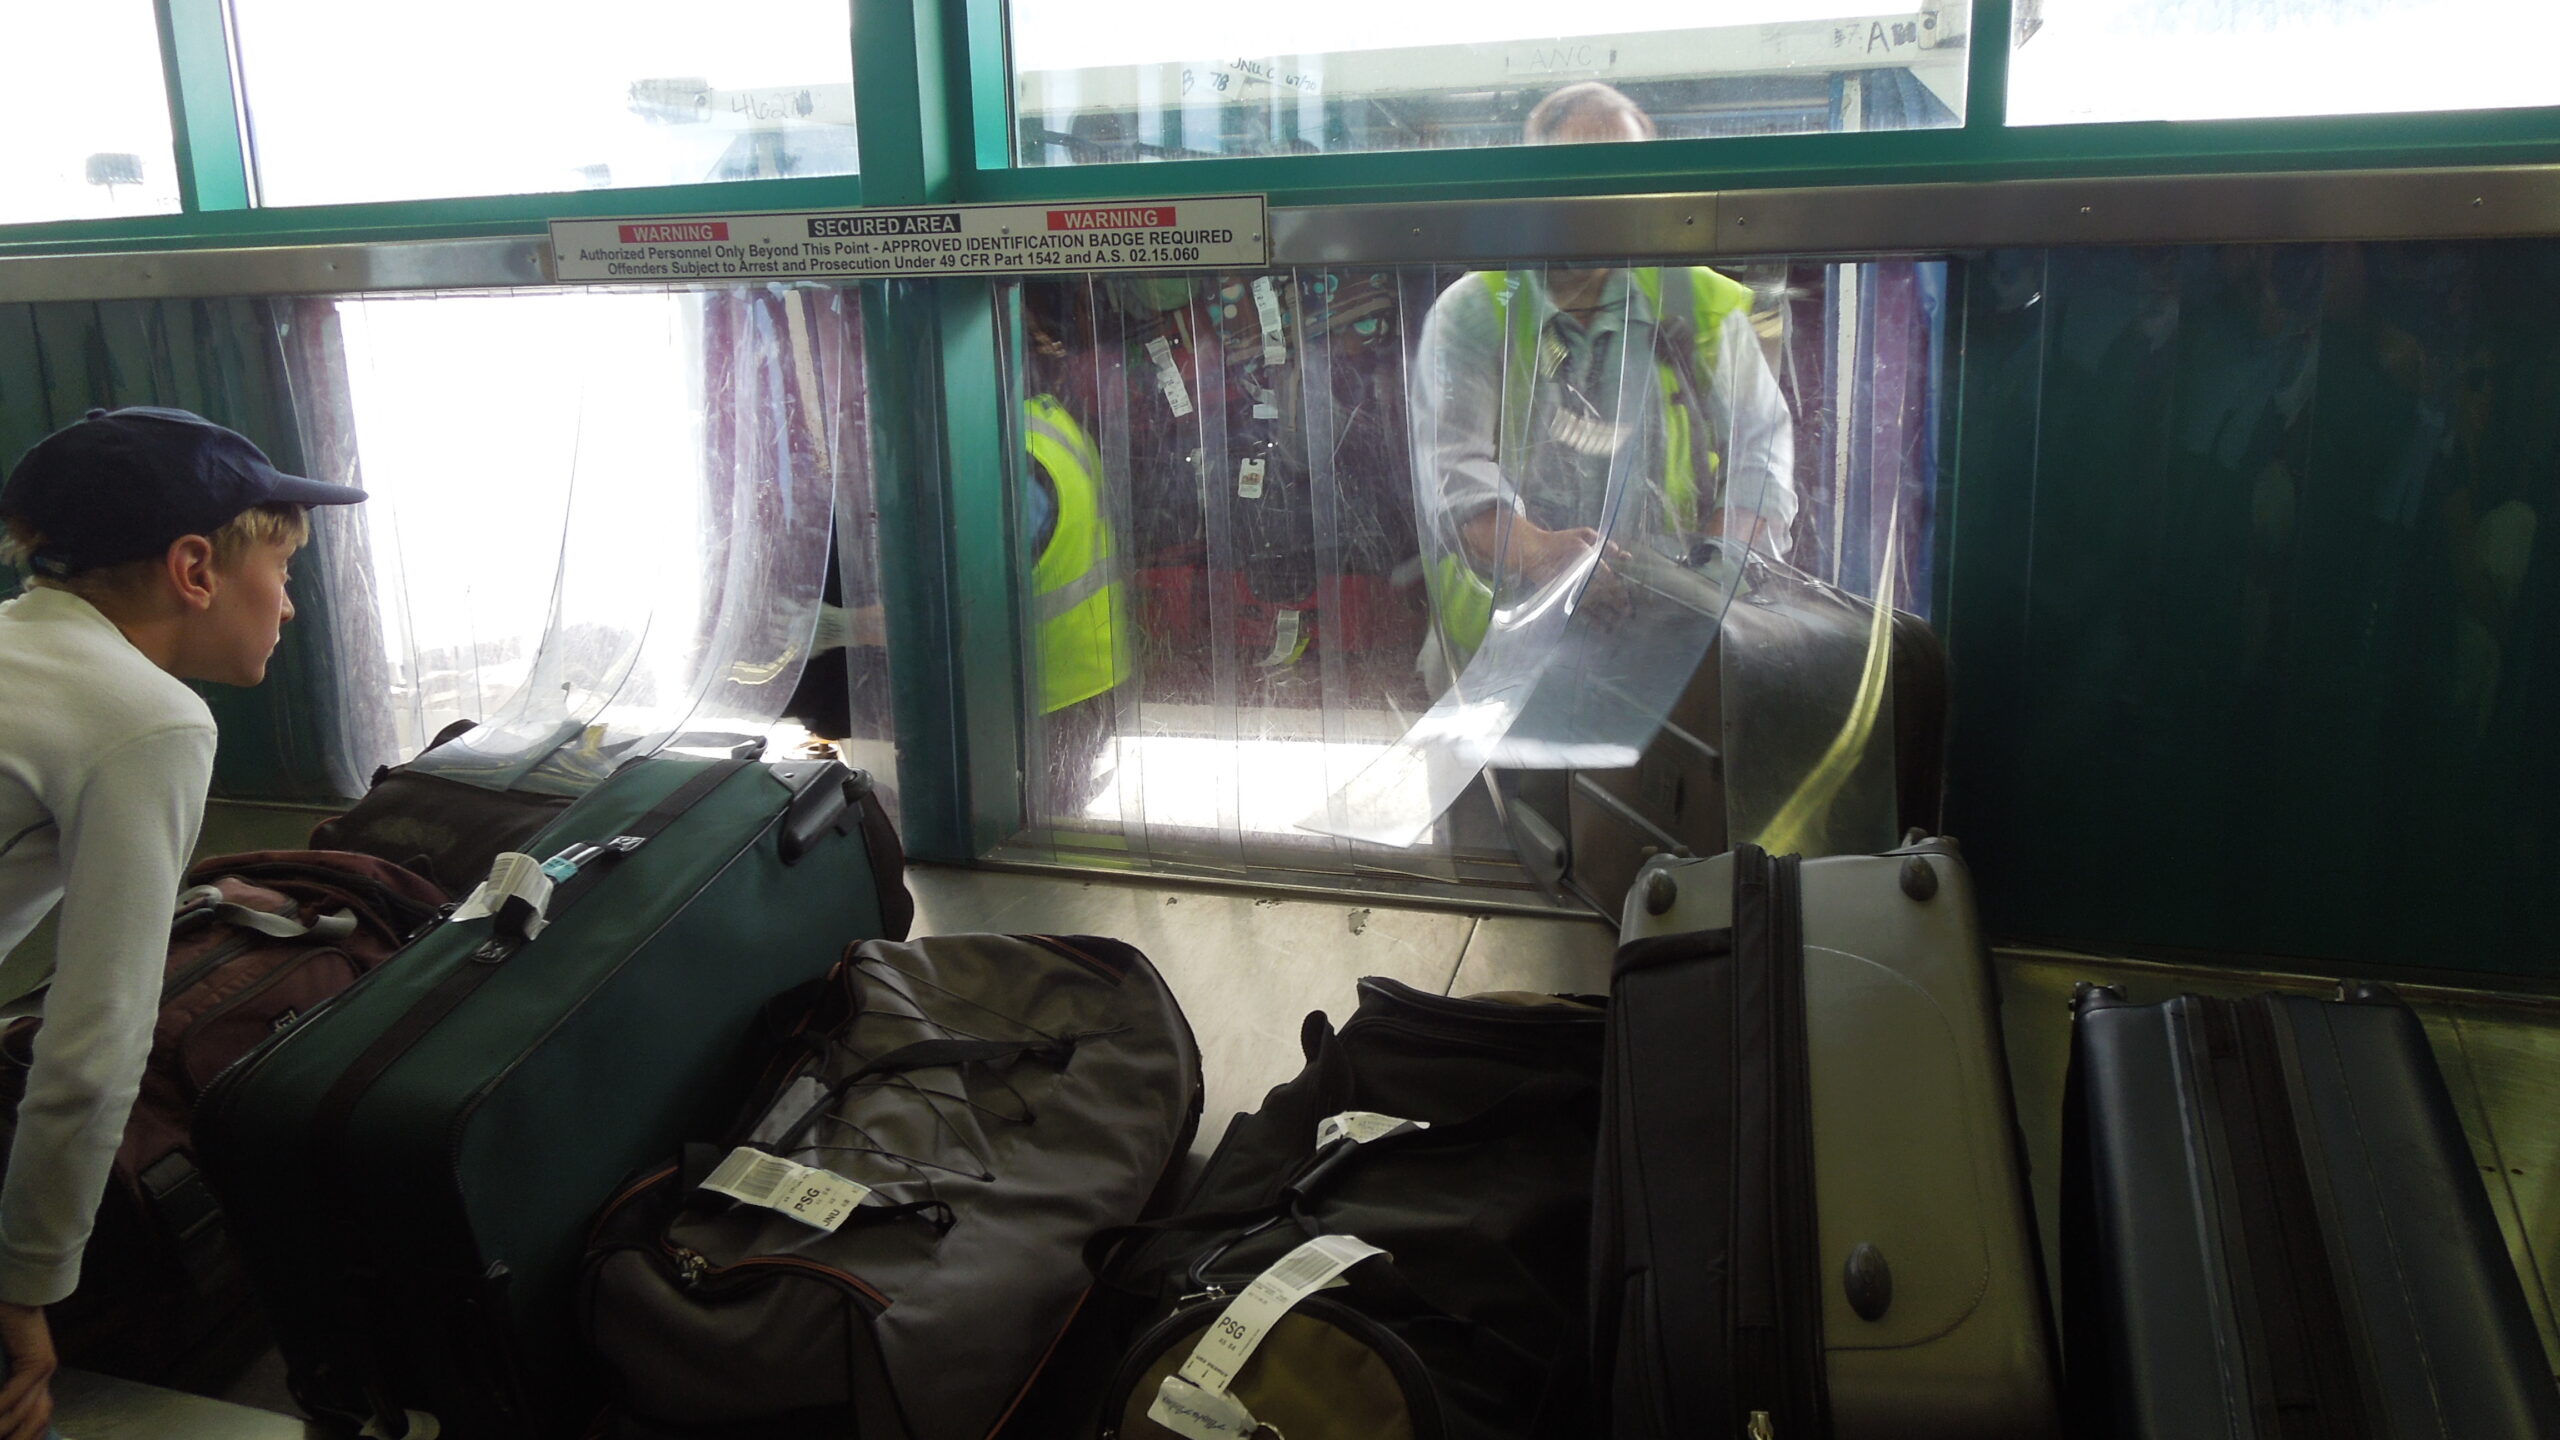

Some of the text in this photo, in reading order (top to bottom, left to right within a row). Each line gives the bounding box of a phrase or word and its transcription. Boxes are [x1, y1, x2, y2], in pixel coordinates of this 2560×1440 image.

[813, 215, 956, 237] SECURED AREA
[1063, 209, 1159, 229] WARNING
[632, 224, 714, 242] WARNING
[579, 247, 645, 261] Authorized
[647, 245, 712, 260] Personnel
[715, 244, 745, 261] Only
[748, 243, 799, 260] Beyond
[802, 241, 831, 256] This
[834, 241, 870, 255] Point
[881, 238, 962, 254] APPROVED
[966, 234, 1085, 251] IDENTIFICATION
[1088, 231, 1145, 247] BADGE
[1149, 229, 1233, 246] REQUIRED
[607, 247, 1200, 277] Offenders Subject to Arrest and Prosecution Under 49 CFR Part 1542 and A.S. 02.15.060
[793, 1187, 821, 1212] PSG
[822, 1208, 841, 1227] JNU
[1216, 1315, 1247, 1340] PSG
